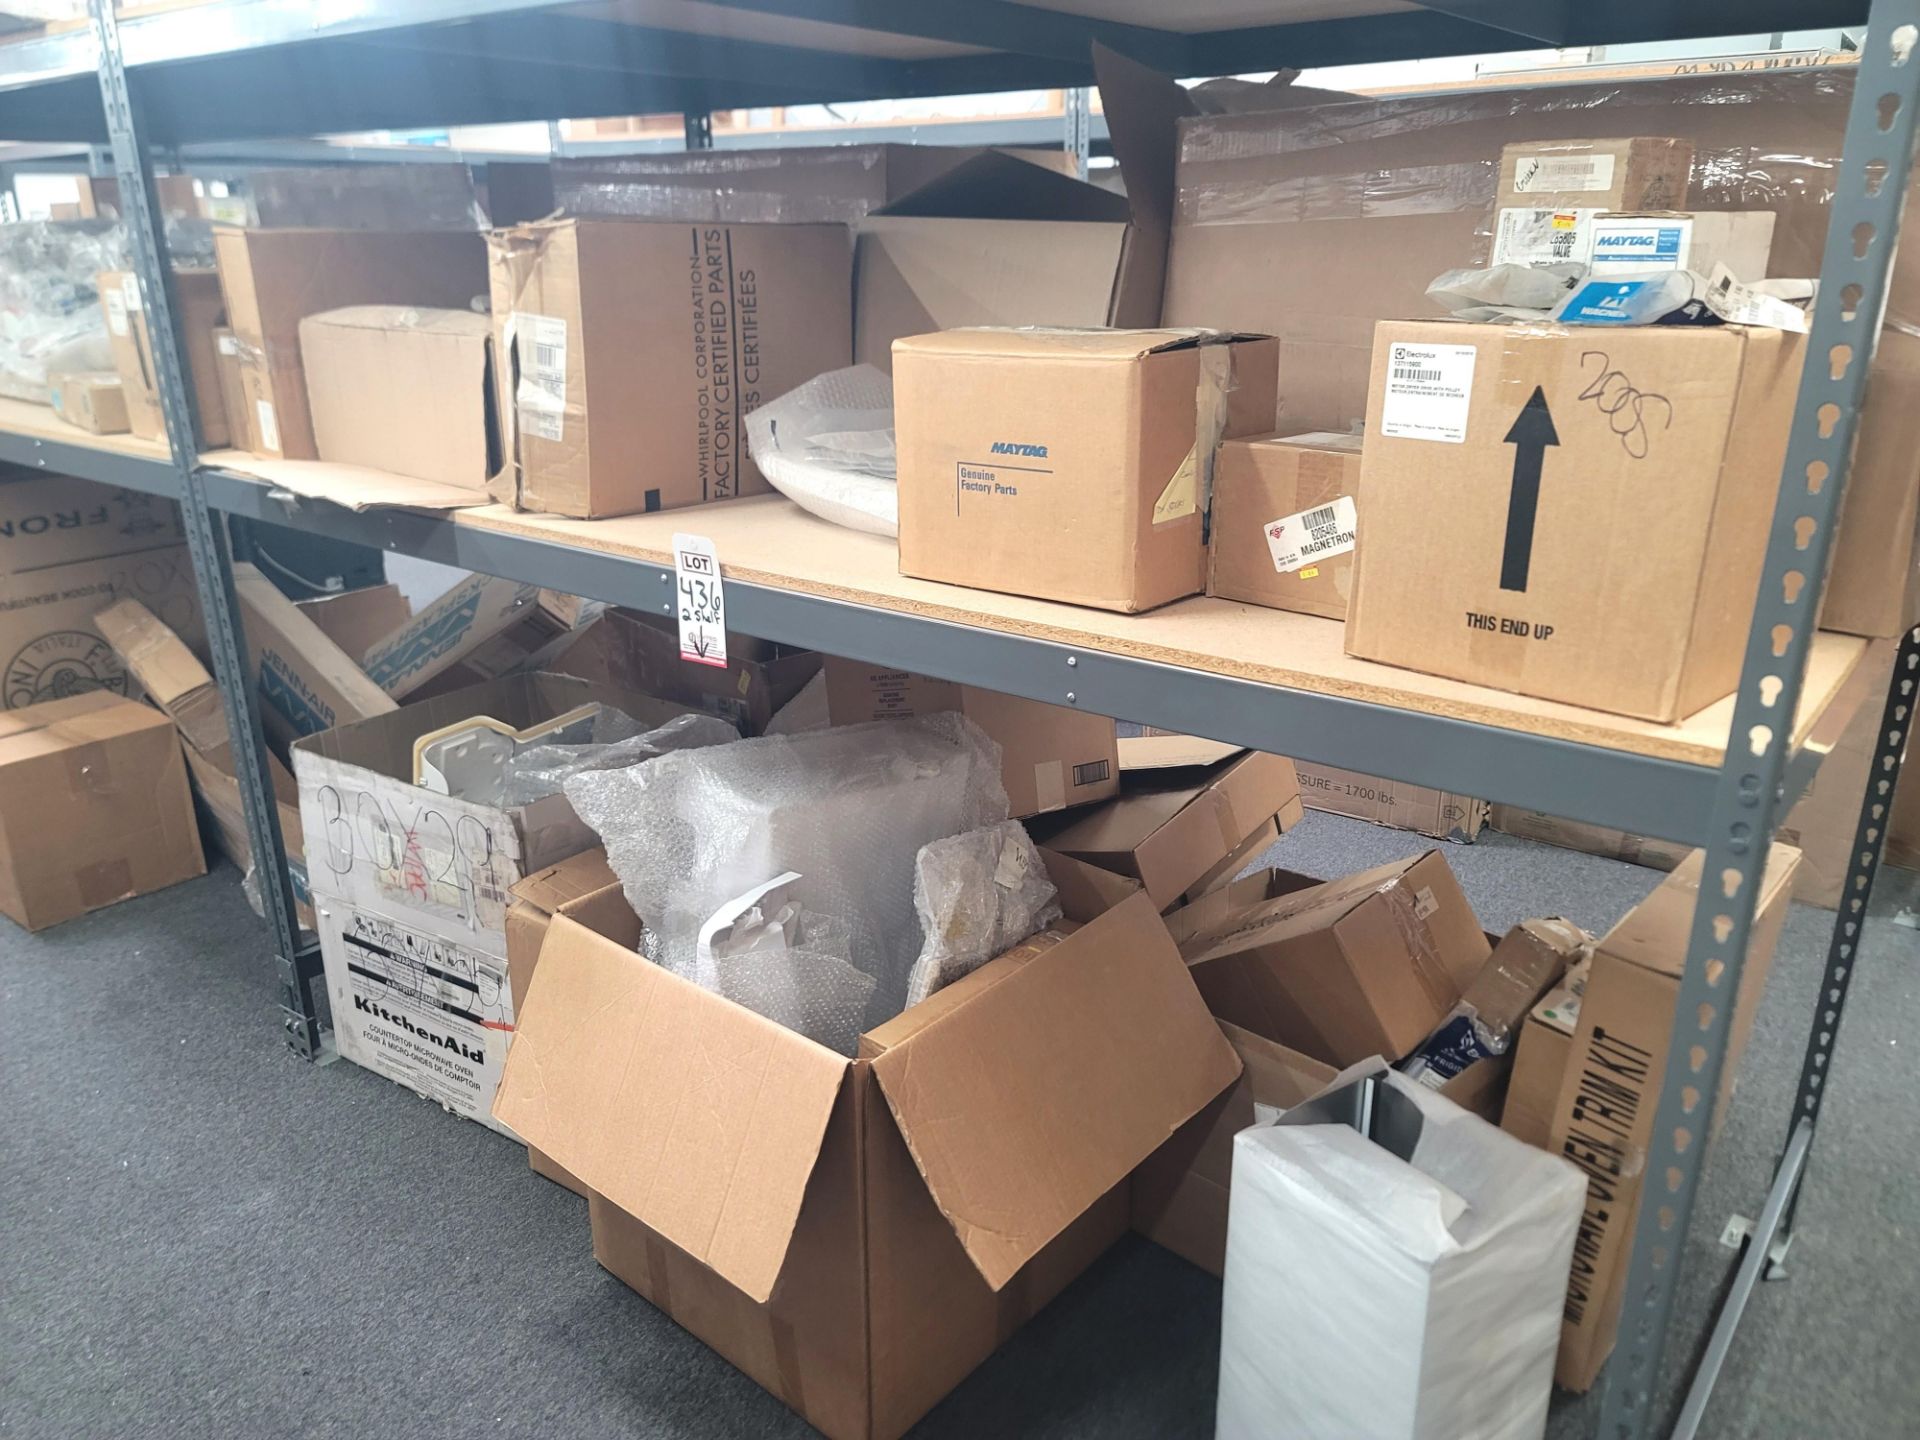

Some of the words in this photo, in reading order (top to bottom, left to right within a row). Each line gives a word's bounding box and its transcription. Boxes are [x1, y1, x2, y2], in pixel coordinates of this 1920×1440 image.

[1552, 245, 1572, 258] VALVE
[1597, 235, 1655, 247] MAYTAG
[704, 228, 724, 294] PARTS
[690, 256, 708, 380] CORPORATION
[710, 300, 730, 403] CERTIFIED
[1406, 350, 1436, 359] Electrolux
[697, 385, 710, 478] WHIRLPOOL
[714, 408, 730, 499] FACTORY
[990, 441, 1048, 459] MAYTAG
[960, 467, 996, 481] Genuine
[961, 479, 992, 495] Factory
[994, 483, 1018, 496] Parts
[1269, 525, 1285, 537] FSP
[1300, 530, 1355, 557] MAGNETRON
[684, 555, 709, 571] LOT
[679, 576, 721, 611] 436
[682, 608, 692, 622] 2
[1465, 611, 1497, 632] THIS
[1500, 618, 1530, 637] END
[1534, 623, 1554, 640] UP
[261, 647, 336, 727] JENN-AIR
[1295, 772, 1331, 791] SSURE
[1345, 783, 1375, 801] 1700
[1377, 791, 1398, 807] lbs.
[353, 993, 485, 1066] KitchenAid
[363, 1031, 382, 1047] FOUR
[387, 1040, 433, 1070] MICRO-ONDES
[434, 1063, 444, 1075] DE
[444, 1069, 482, 1092] COMPTOIR
[368, 1023, 413, 1050] COUNTERTOP
[413, 1043, 454, 1069] MICROWAVE
[454, 1062, 474, 1078] OVEN
[1433, 1055, 1464, 1074] FRIGID
[1586, 1025, 1653, 1084] KIT
[1572, 1069, 1641, 1140] TRIM
